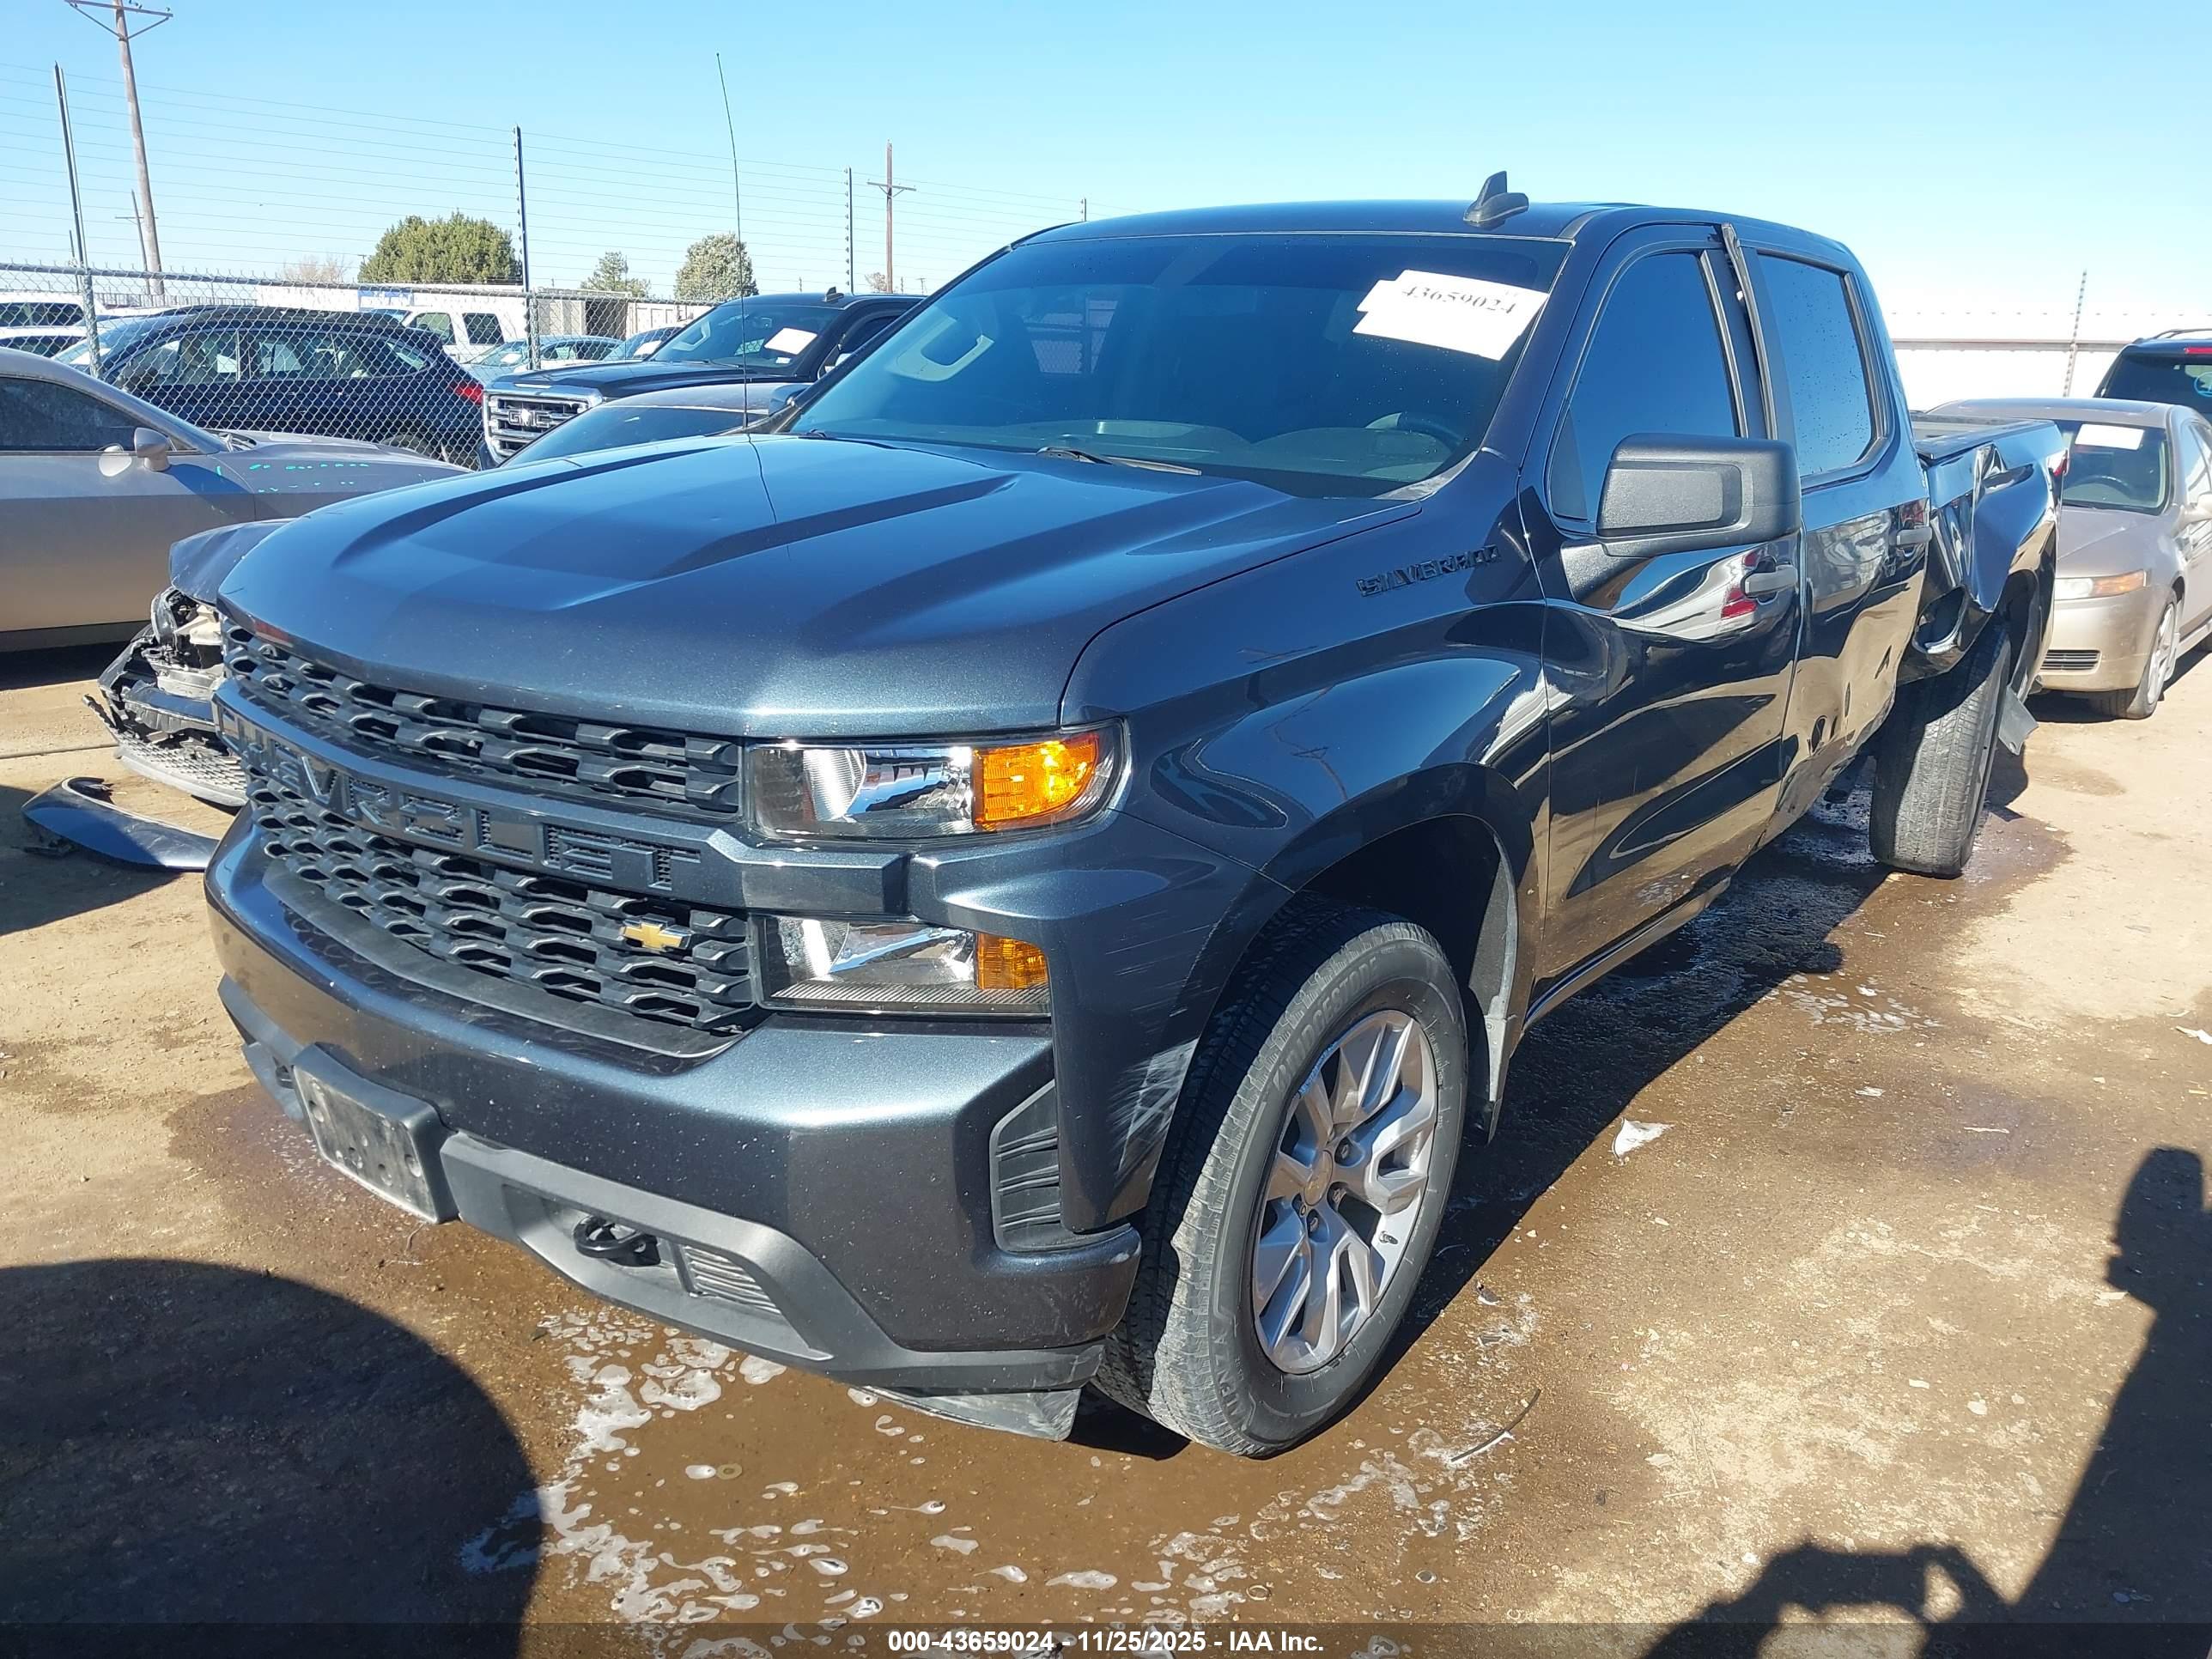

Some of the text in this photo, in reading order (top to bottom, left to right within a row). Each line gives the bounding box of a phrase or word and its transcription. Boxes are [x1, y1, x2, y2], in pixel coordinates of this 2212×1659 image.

[1401, 285, 1517, 314] 43659024
[508, 410, 550, 428] GMC
[1356, 544, 1501, 597] SILVERADO
